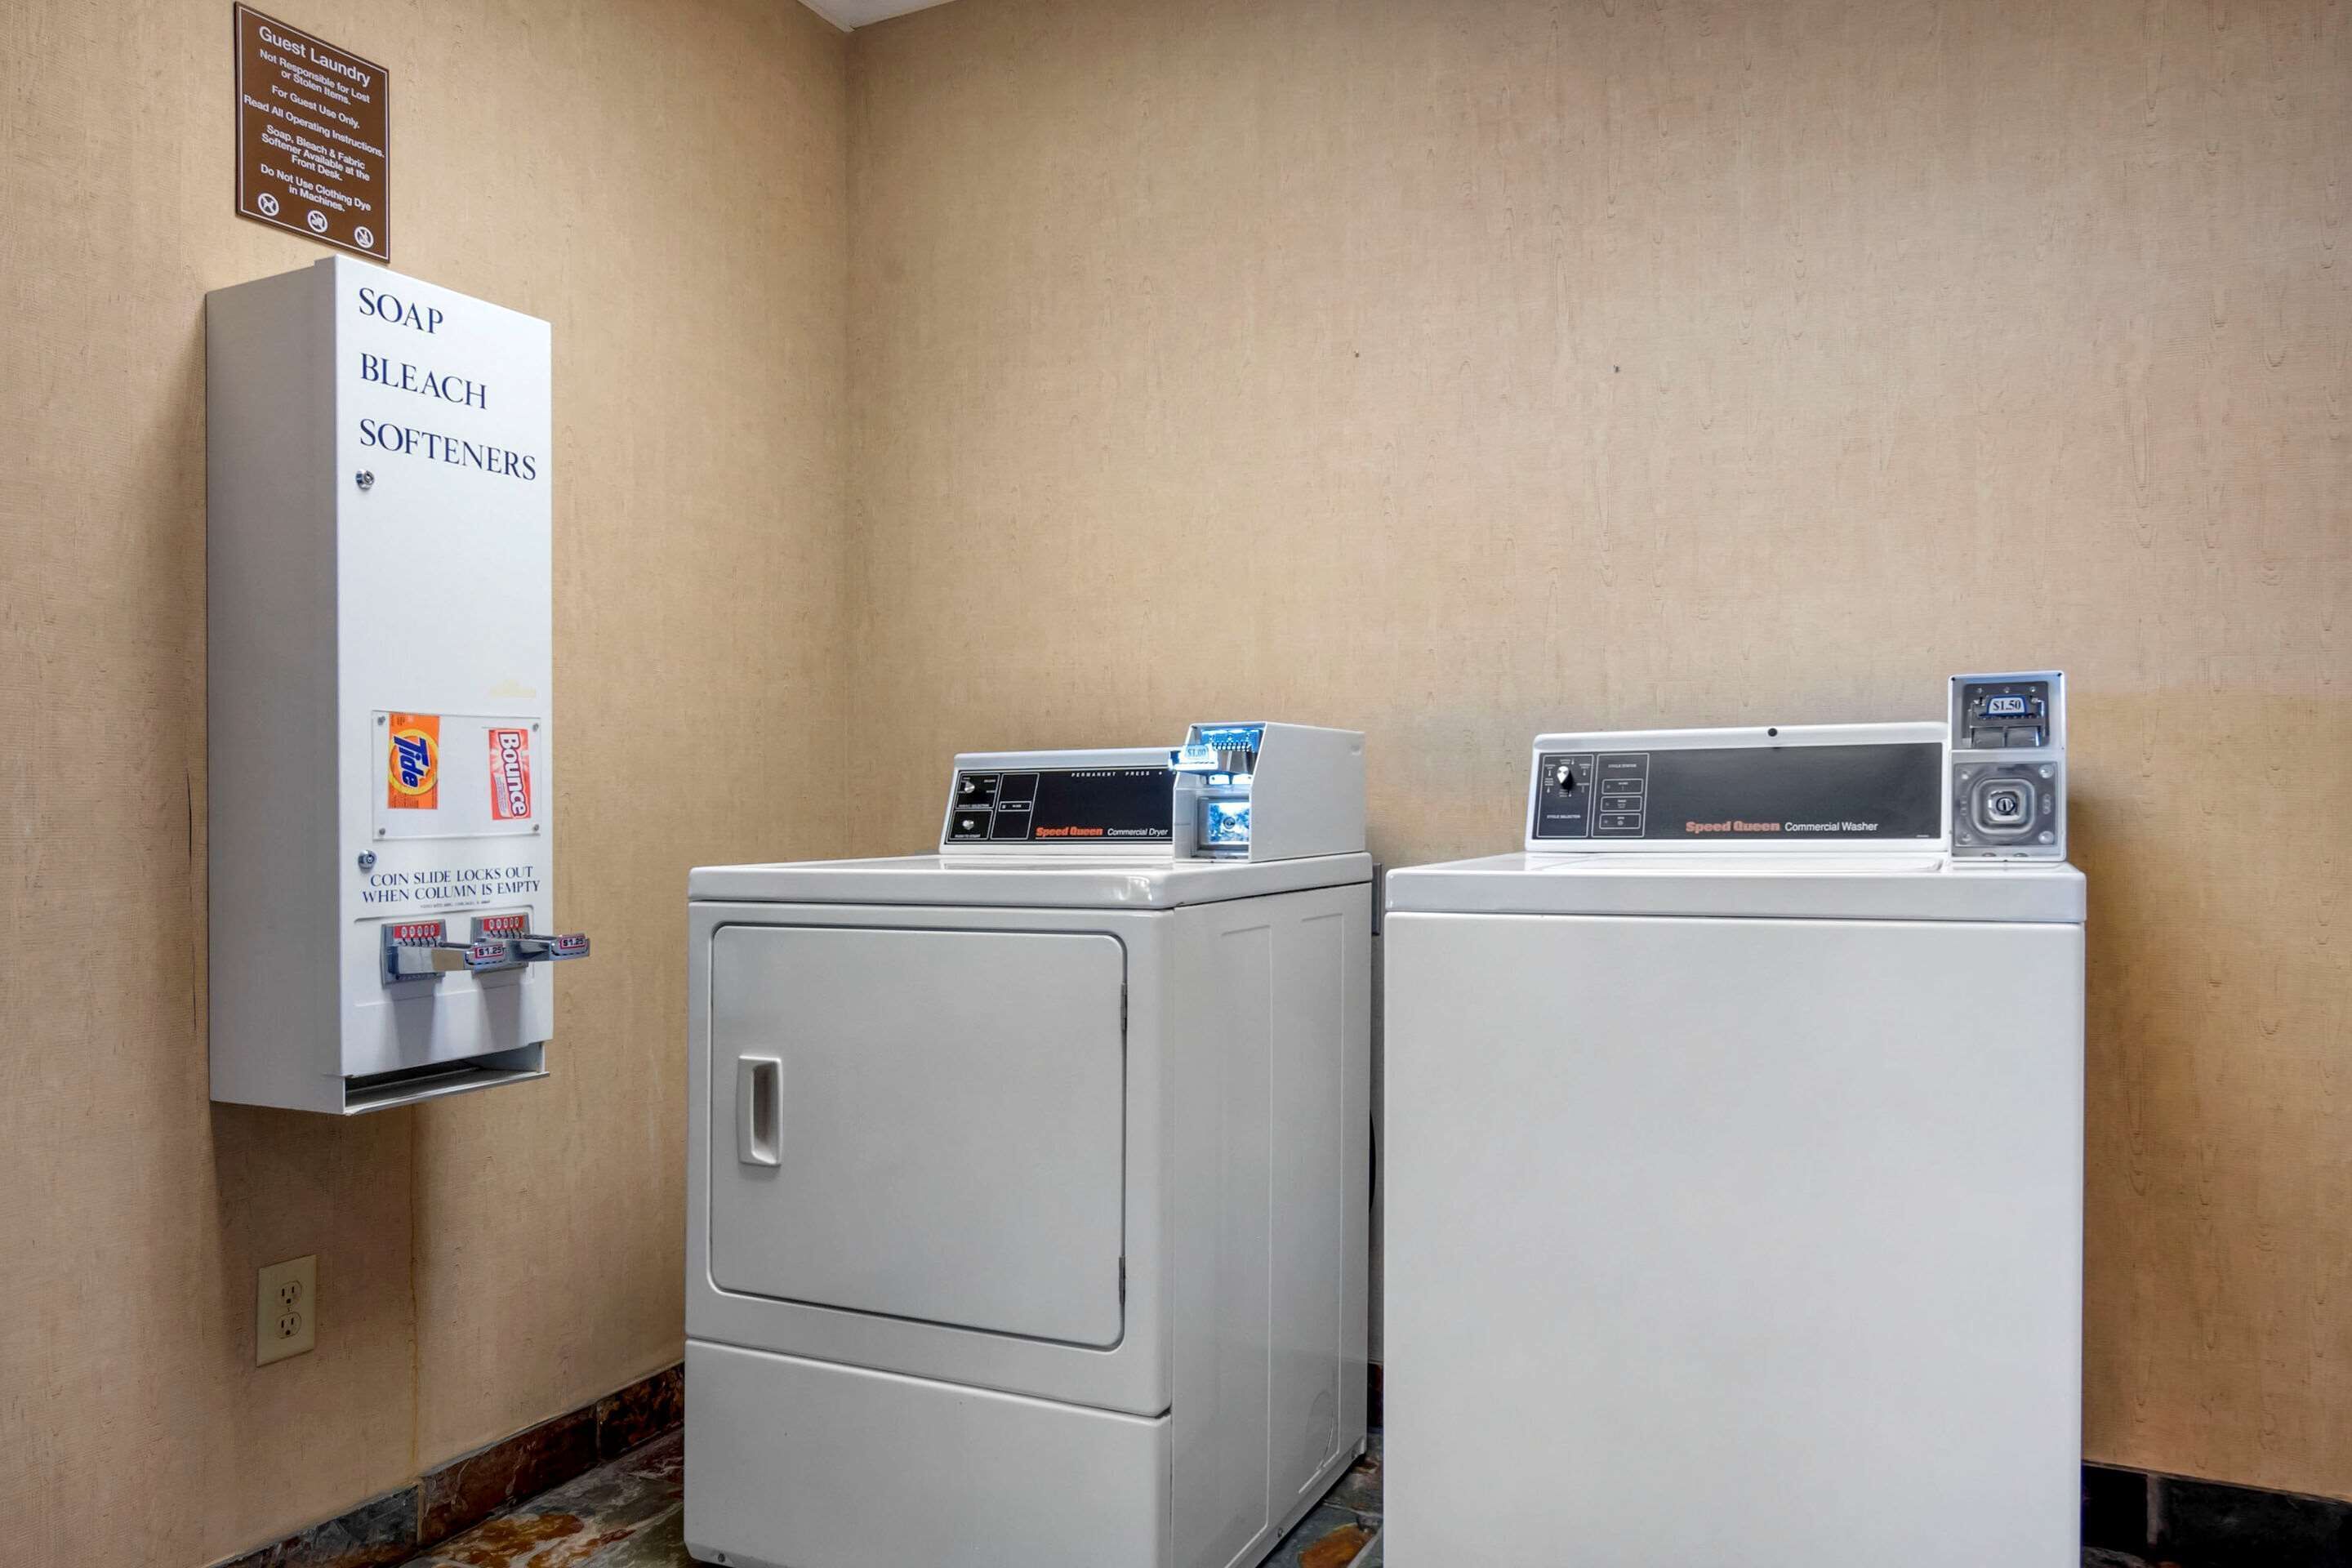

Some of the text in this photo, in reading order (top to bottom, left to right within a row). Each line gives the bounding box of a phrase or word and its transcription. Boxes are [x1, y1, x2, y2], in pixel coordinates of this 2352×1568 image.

[259, 26, 370, 87] Guest Laundry
[260, 49, 370, 104] Not Responsible for Lost
[272, 85, 360, 129] For Guest Use Only.
[281, 70, 351, 105] or Stolen Items.
[244, 94, 385, 158] Read All Operating Instructions.
[261, 133, 370, 181] Softener Available at the
[292, 154, 343, 181] Front Desk.
[296, 136, 327, 155] Bleach
[329, 149, 336, 159] &
[338, 152, 365, 170] Fabric
[261, 163, 372, 212] Do Not Use Clothing Dye
[289, 185, 345, 212] in Machines.
[359, 287, 443, 334] SOAP
[360, 353, 487, 410] BLEACH
[359, 418, 537, 481] SOFTENERS
[1993, 699, 2021, 711] $1.50
[393, 734, 430, 788] Tide
[497, 732, 528, 817] Bounce
[1036, 826, 1168, 838] Speed Queen Commercial Dryer
[1685, 820, 1878, 834] Speed Queen Commercial Washer
[362, 880, 541, 903] WHEN COLUMN IS EMPTY
[371, 866, 533, 887] COIN SLIDE LOCKS OUT
